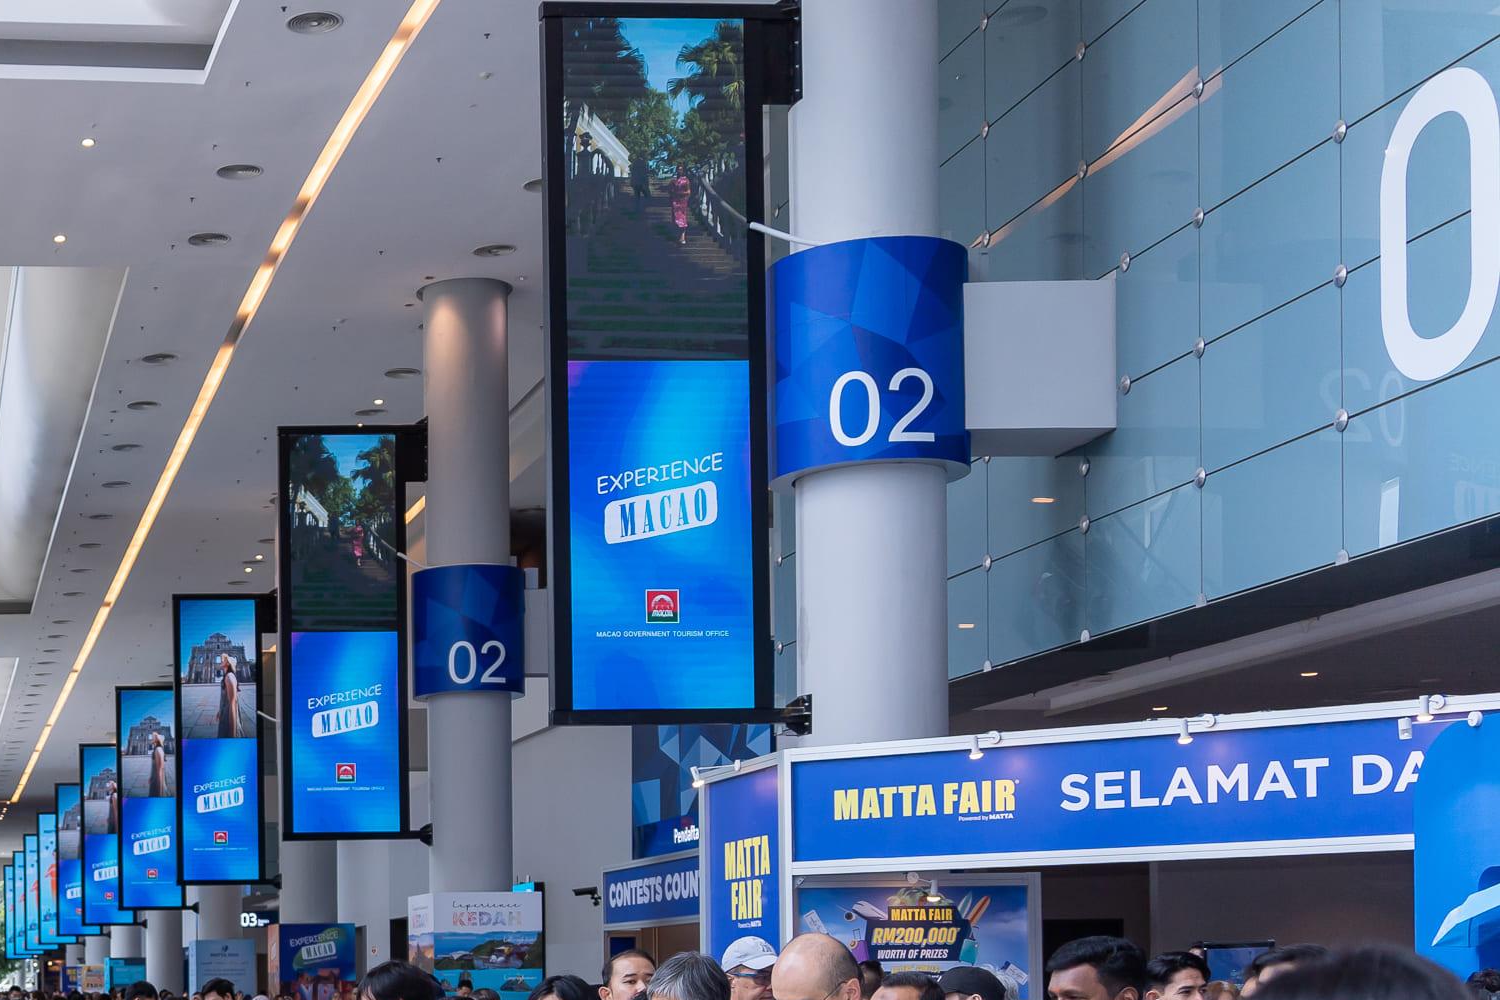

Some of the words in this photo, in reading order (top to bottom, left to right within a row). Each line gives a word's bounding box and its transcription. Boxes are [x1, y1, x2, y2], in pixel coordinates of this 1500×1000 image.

[828, 367, 936, 447] 02
[596, 451, 724, 496] EXPERIENCE
[619, 487, 708, 538] MACAO
[596, 630, 622, 638] MACAO
[623, 630, 671, 638] GOVERNMENT
[673, 629, 704, 638] TOURISM
[705, 629, 730, 638] OFFICE
[447, 639, 507, 685] 02
[307, 683, 383, 710] EXPERIENCE
[321, 704, 373, 734] MACAO
[193, 775, 247, 794] EXPERIENCE
[1059, 756, 1329, 813] SELAMAT
[203, 790, 240, 811] MACAO
[832, 783, 938, 822] MATTA
[942, 778, 1017, 815] FAIR
[989, 813, 1014, 821] MATTA
[724, 834, 771, 881] MATTA
[451, 899, 522, 911] Experience
[608, 876, 663, 909] CONTESTS
[730, 878, 763, 921] FAIR
[240, 912, 258, 927] 03
[451, 911, 522, 927] KEDAH
[891, 908, 926, 921] MATTA
[928, 907, 953, 921] FAIR
[290, 930, 339, 947] EXPERIENCE
[877, 949, 907, 960] WORTH
[908, 949, 919, 959] OF
[920, 948, 950, 959] PRIZES
